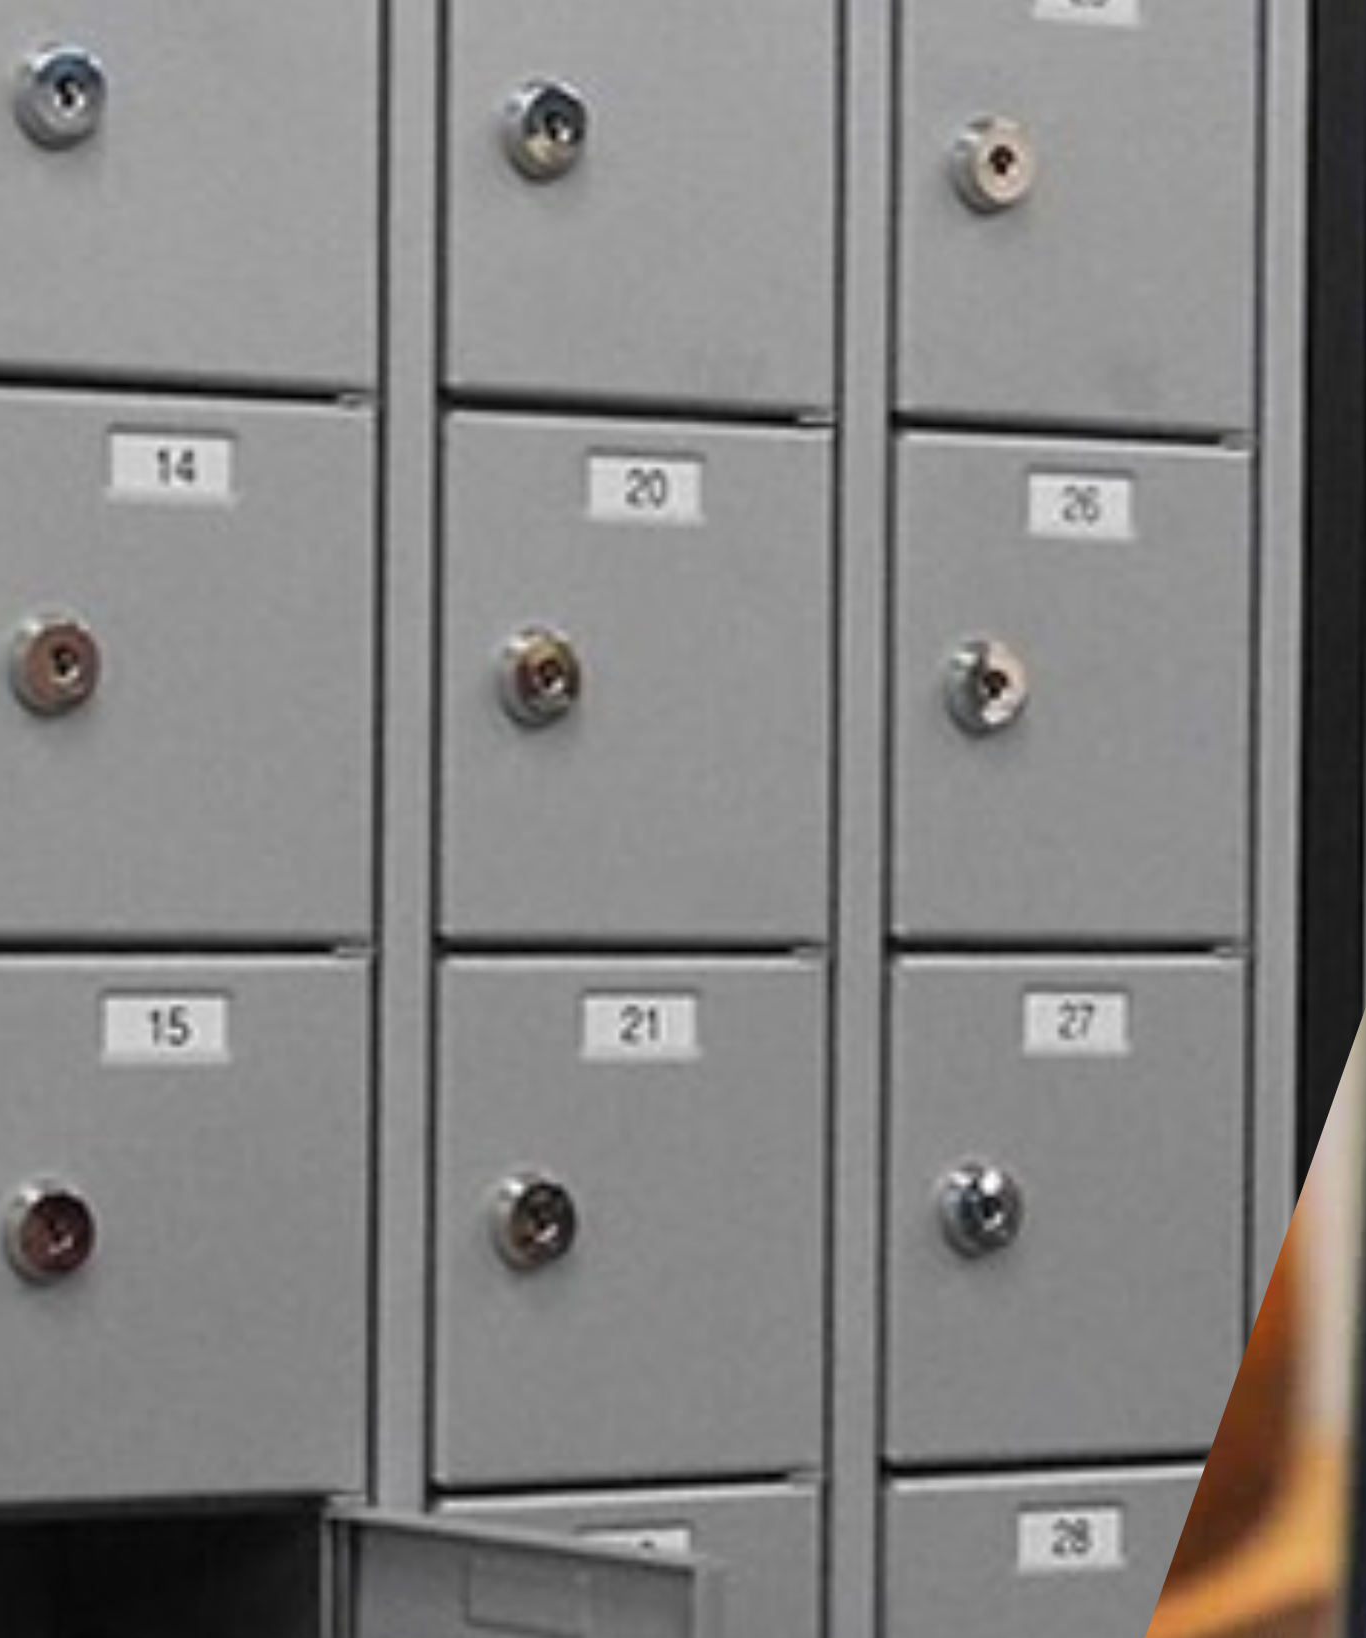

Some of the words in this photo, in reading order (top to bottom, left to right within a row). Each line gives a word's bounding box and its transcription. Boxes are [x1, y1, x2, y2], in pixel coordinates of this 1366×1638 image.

[156, 448, 197, 486] 14
[625, 467, 668, 509] 20
[1062, 485, 1101, 525] 26
[150, 1006, 191, 1047] 15
[620, 1005, 657, 1044] 21
[1058, 1002, 1096, 1040] 27
